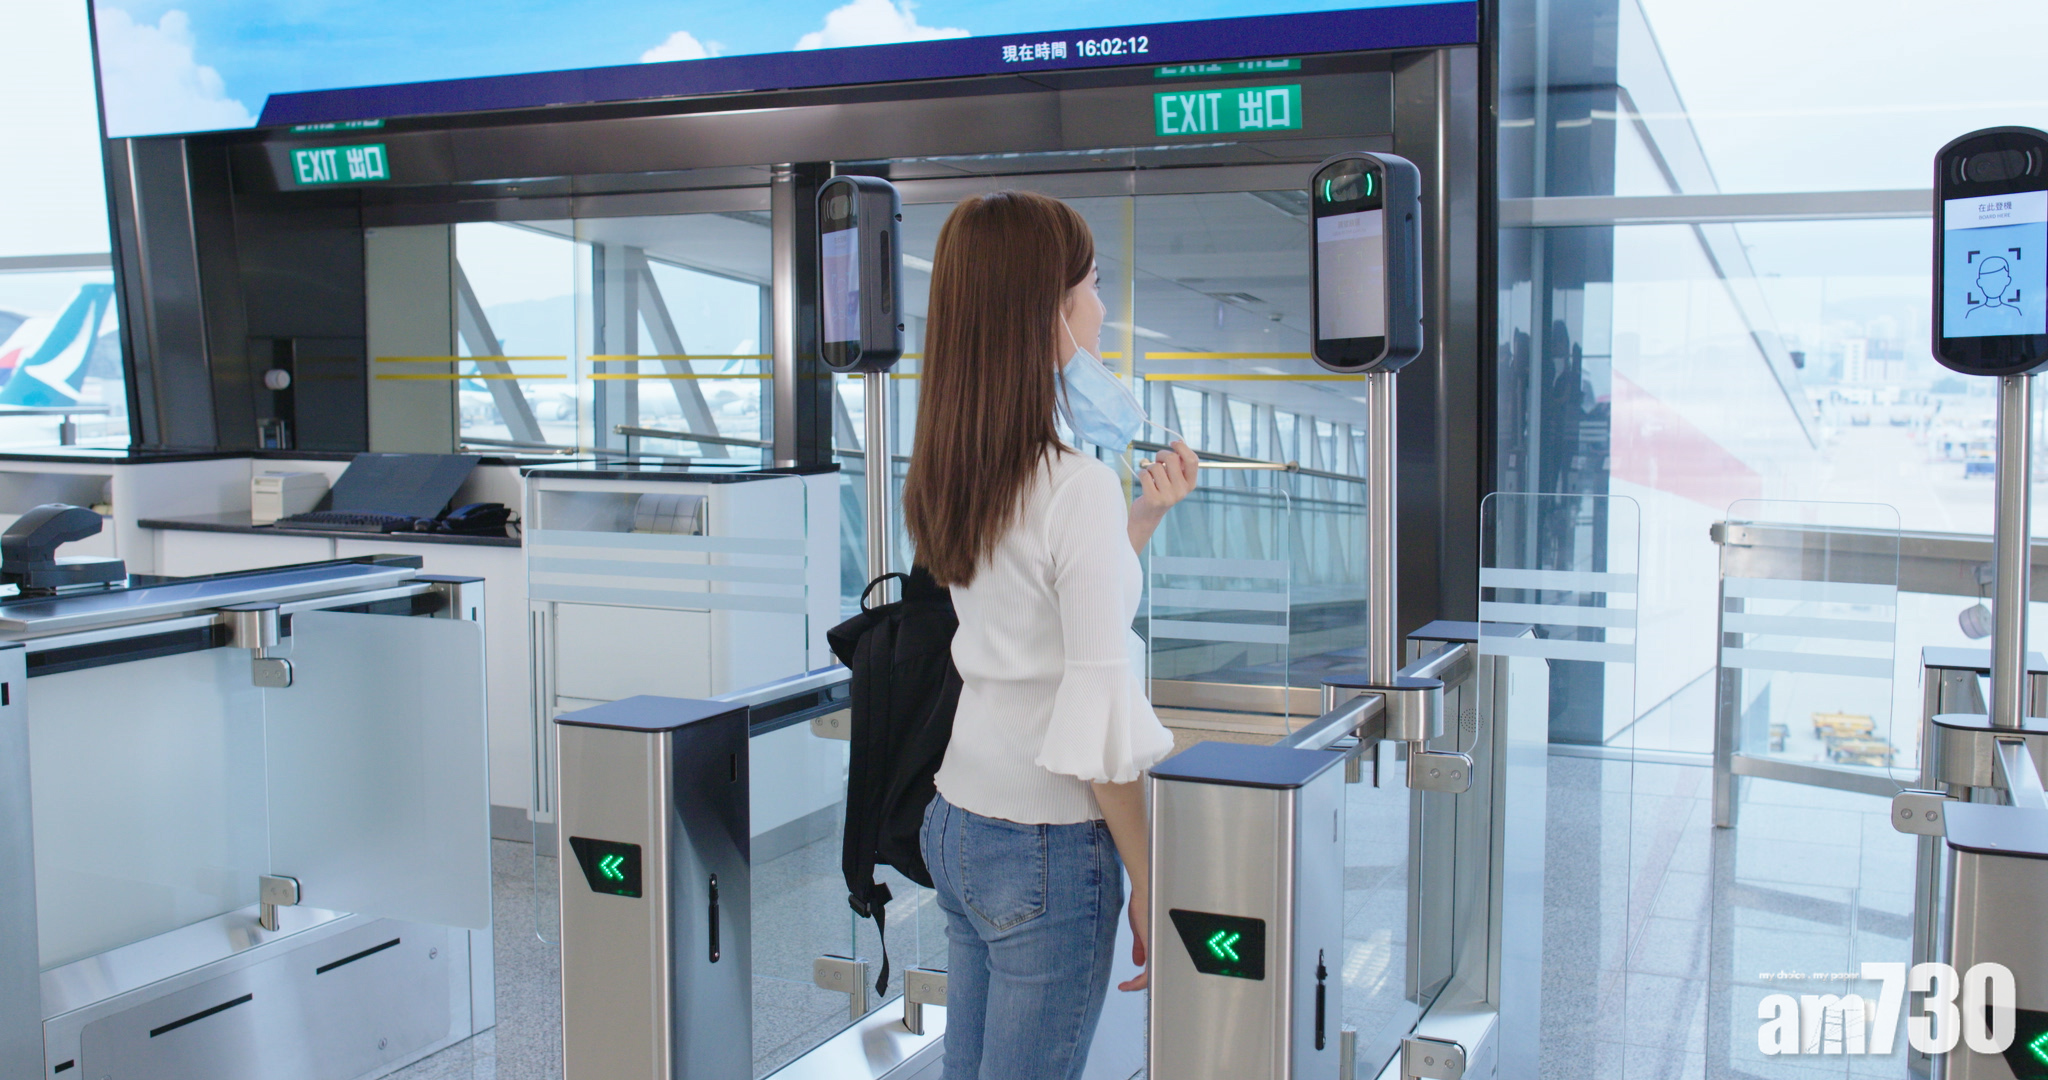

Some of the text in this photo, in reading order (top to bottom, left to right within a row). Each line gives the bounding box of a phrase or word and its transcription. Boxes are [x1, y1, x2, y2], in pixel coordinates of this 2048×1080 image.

[1002, 36, 1149, 63] 現在時間 16:02:12
[1161, 88, 1291, 134] EXIT 出口
[296, 147, 384, 183] EXIT 出口
[1978, 201, 2012, 212] 在此登機
